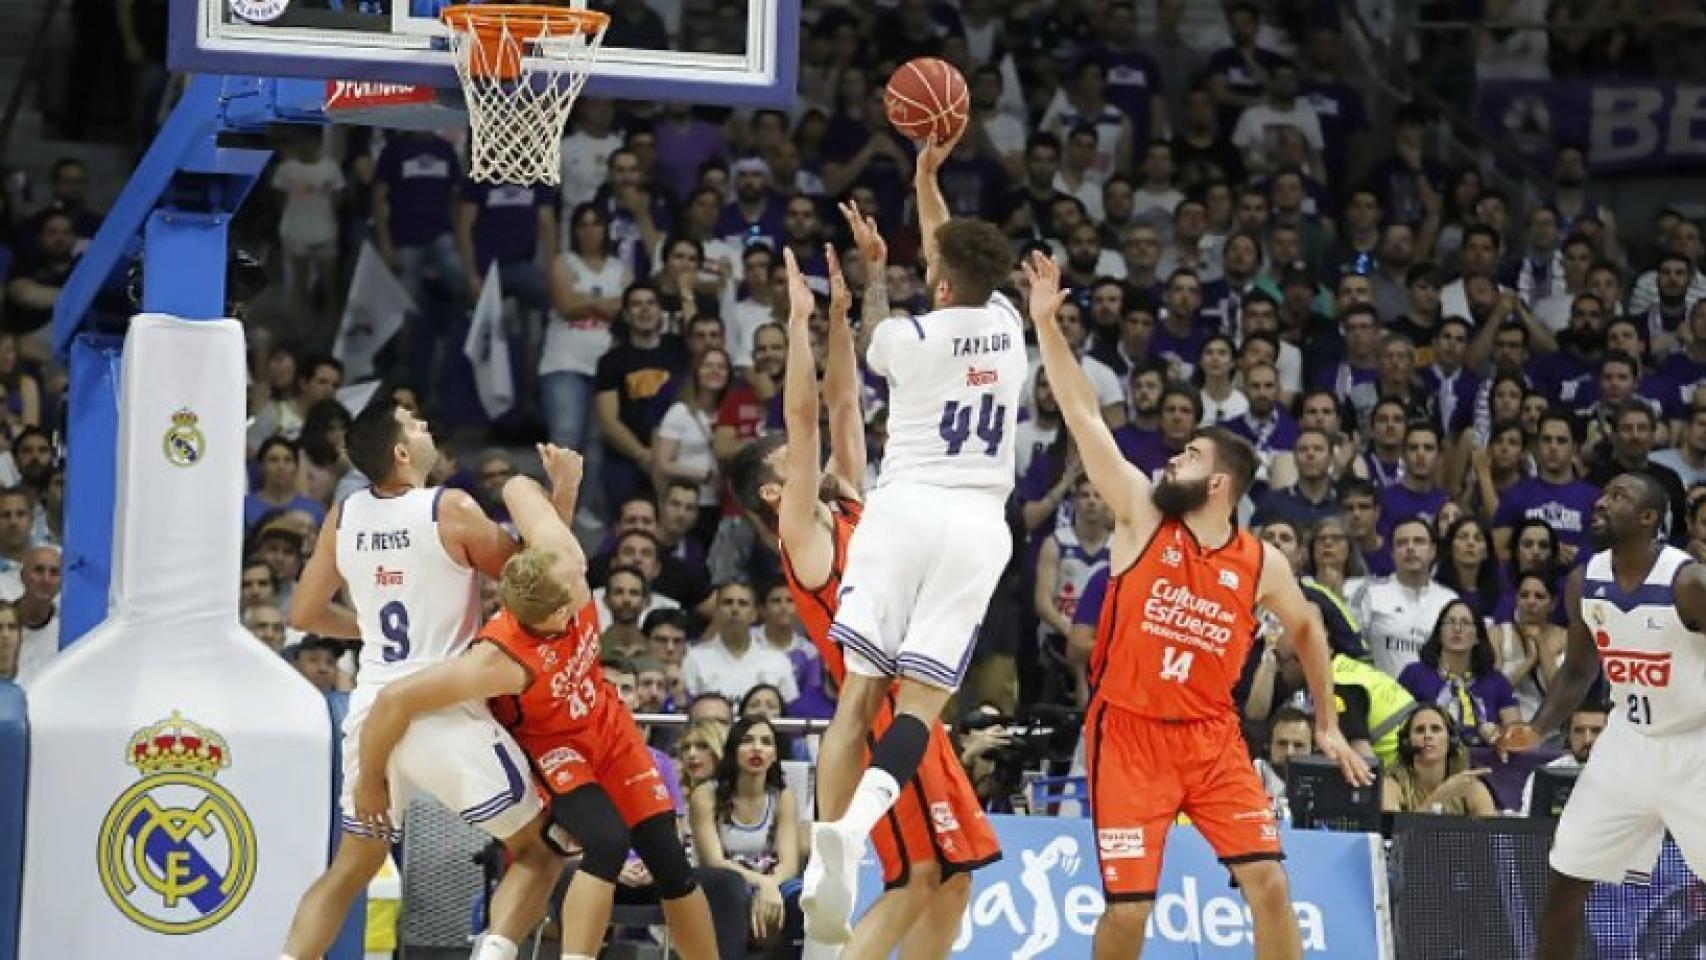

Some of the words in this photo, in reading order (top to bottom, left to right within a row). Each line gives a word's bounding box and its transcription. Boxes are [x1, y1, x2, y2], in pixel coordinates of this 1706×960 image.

[952, 333, 1012, 357] TAYLOR
[939, 393, 1006, 456] 44
[371, 528, 410, 550] REYES
[379, 600, 411, 662] 9
[1159, 646, 1195, 684] 14
[569, 676, 596, 720] 43
[1626, 693, 1652, 725] 21
